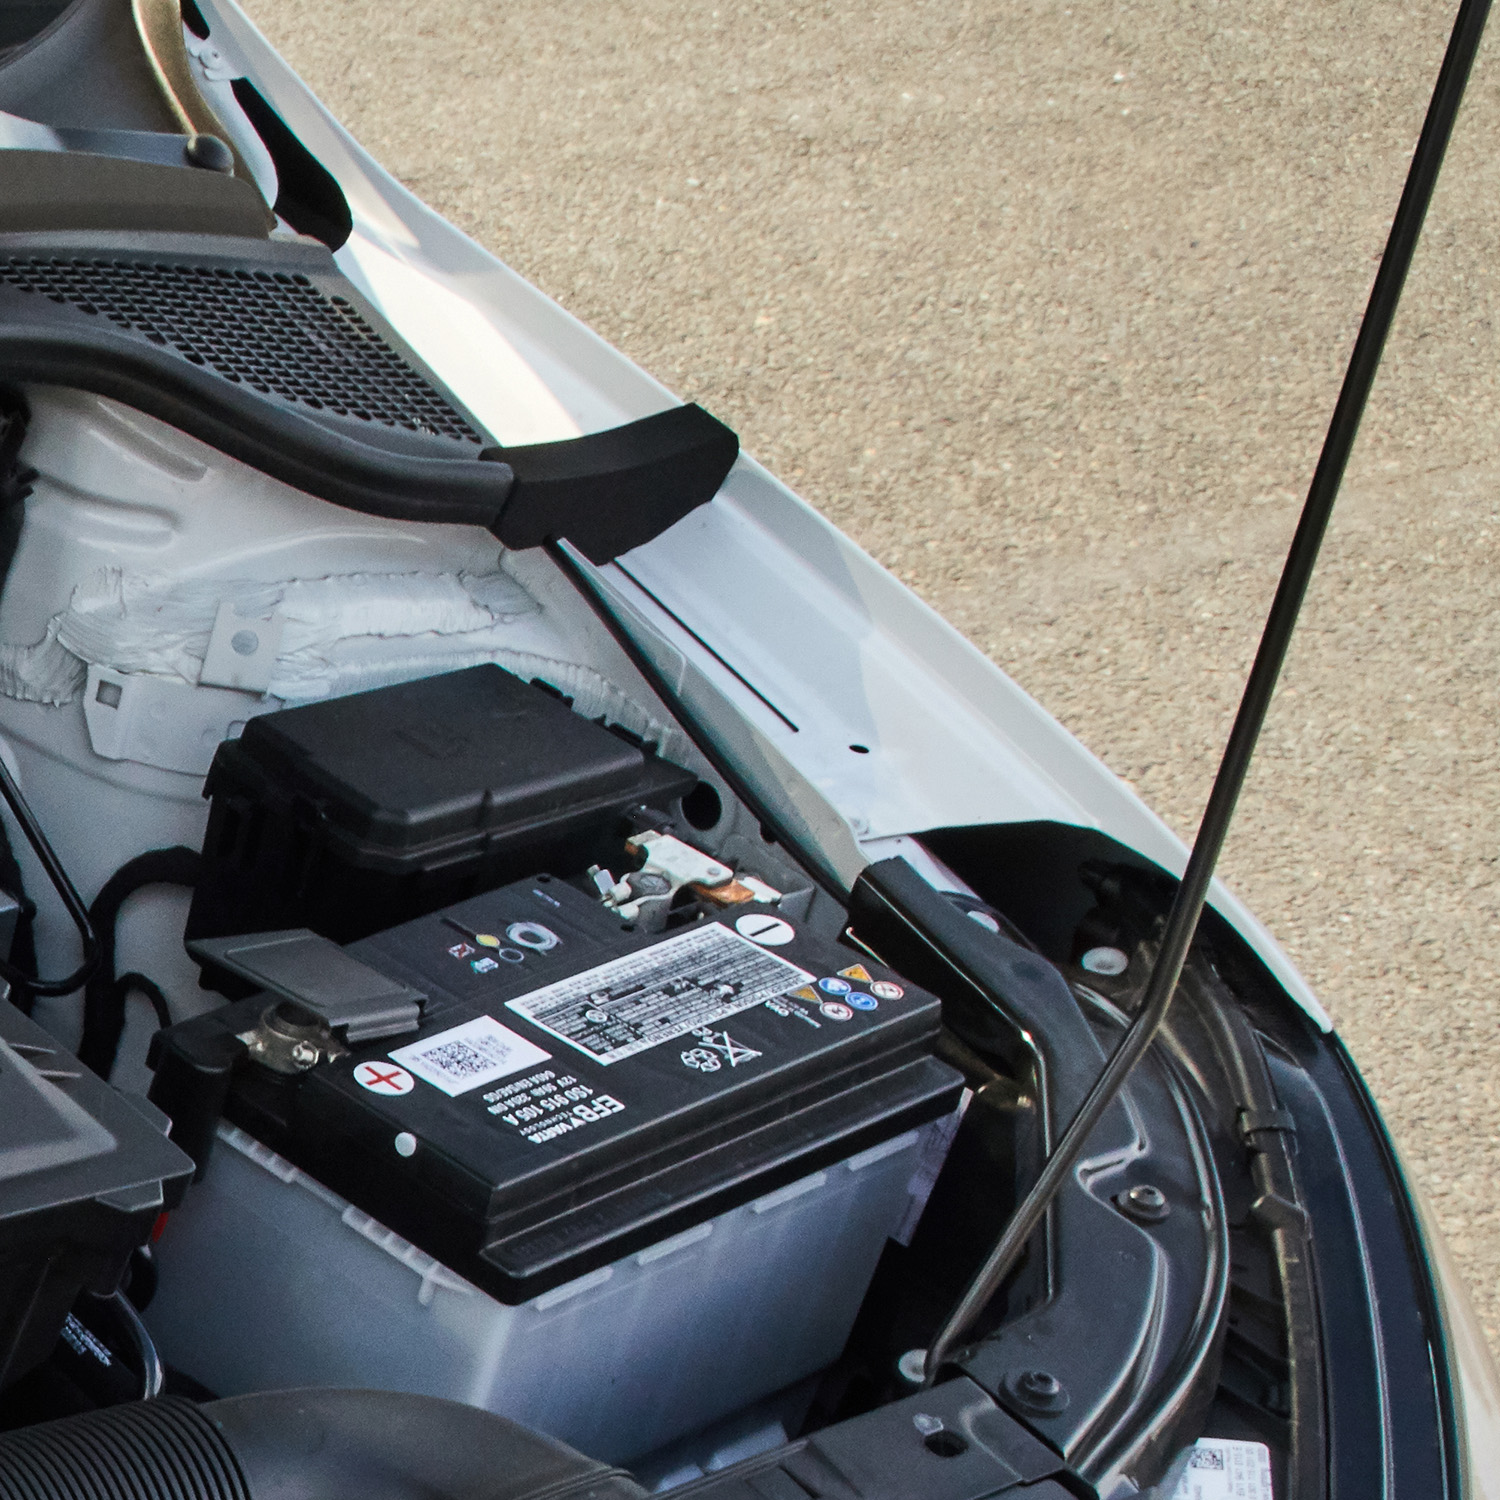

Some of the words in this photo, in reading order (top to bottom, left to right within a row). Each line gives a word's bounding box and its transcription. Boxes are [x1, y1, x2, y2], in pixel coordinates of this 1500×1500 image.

[552, 1073, 579, 1088] 12V
[511, 1102, 547, 1122] 105
[536, 1092, 572, 1112] 915
[568, 1092, 627, 1124] EFB
[499, 1112, 523, 1126] A
[525, 1120, 574, 1146] VARTA
